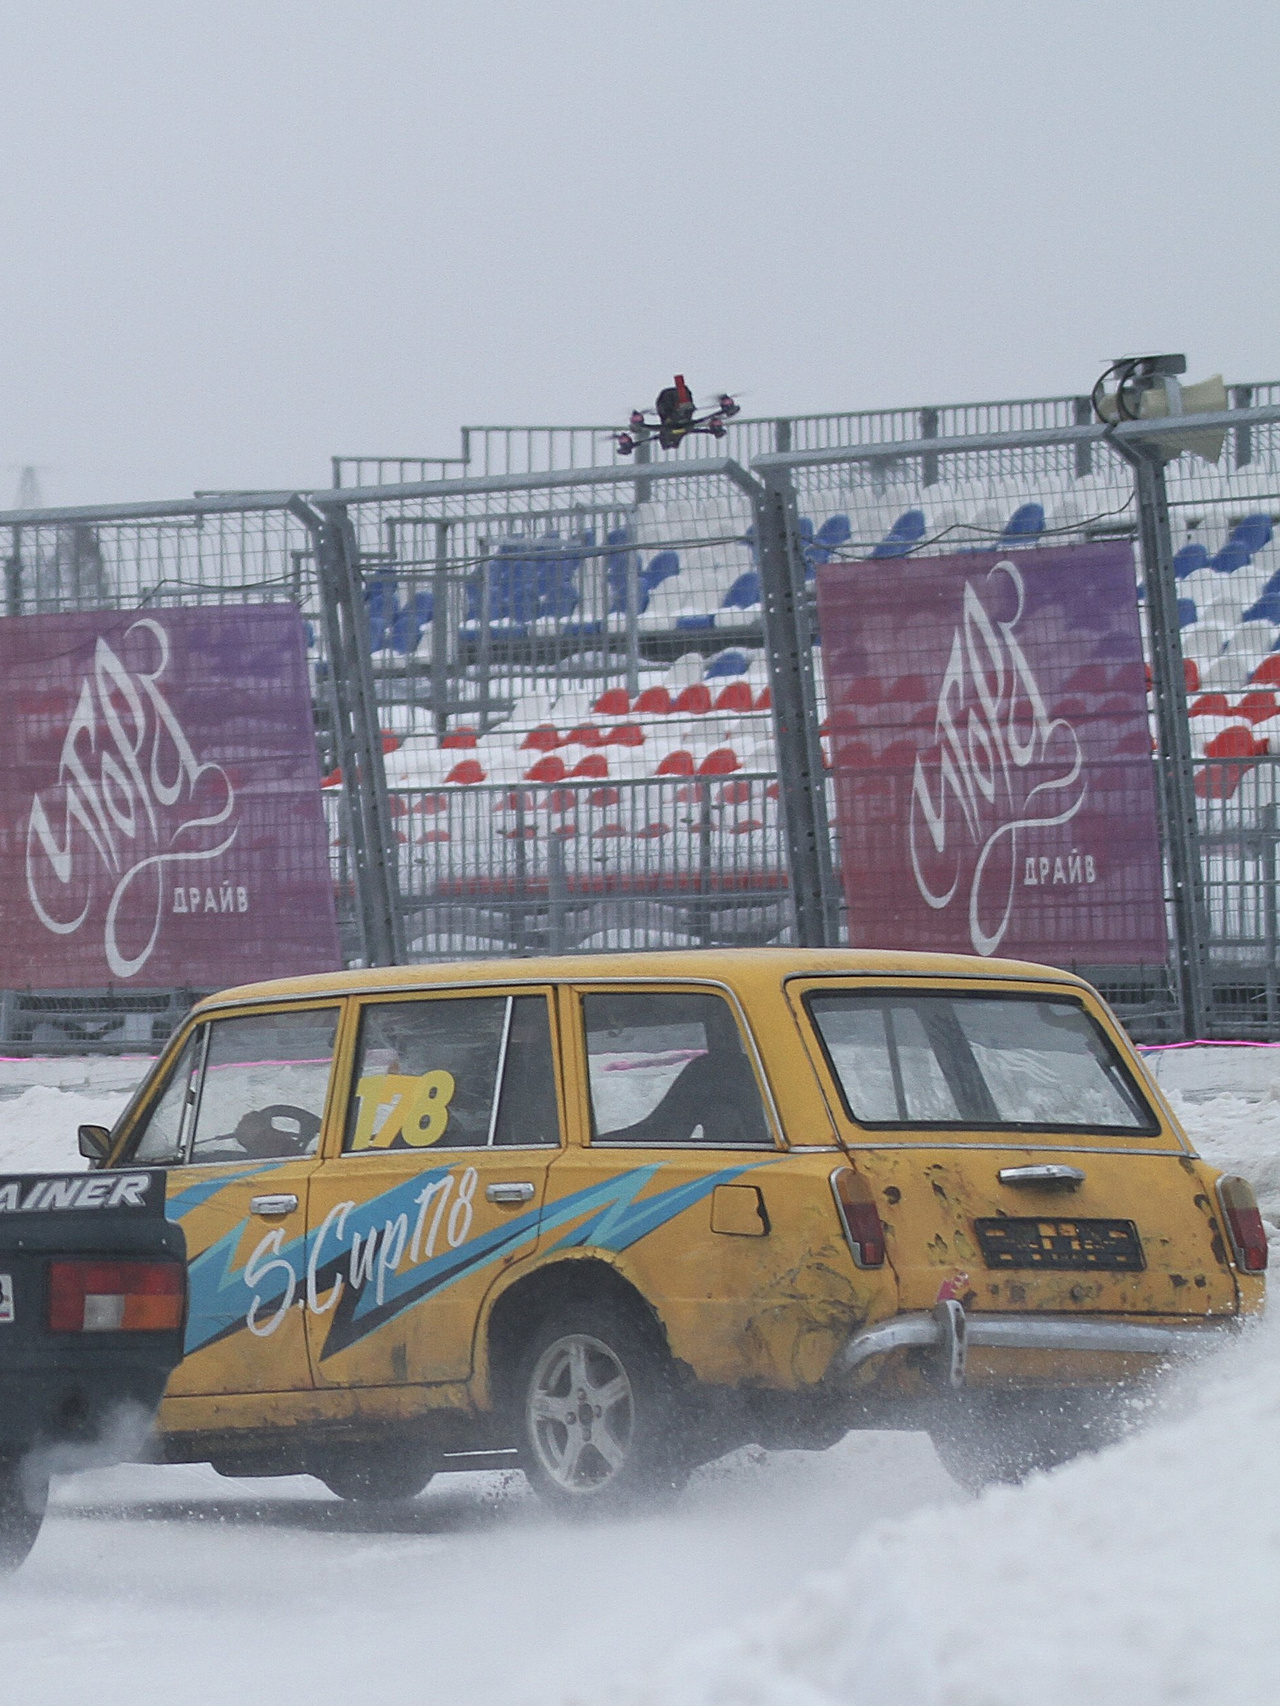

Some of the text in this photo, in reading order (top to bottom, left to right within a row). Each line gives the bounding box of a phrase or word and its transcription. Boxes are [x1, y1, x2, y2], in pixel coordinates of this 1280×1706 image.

[1023, 848, 1097, 885] ДРАЙВ
[172, 880, 249, 913] ДРАЙВ
[352, 1069, 455, 1150] 178
